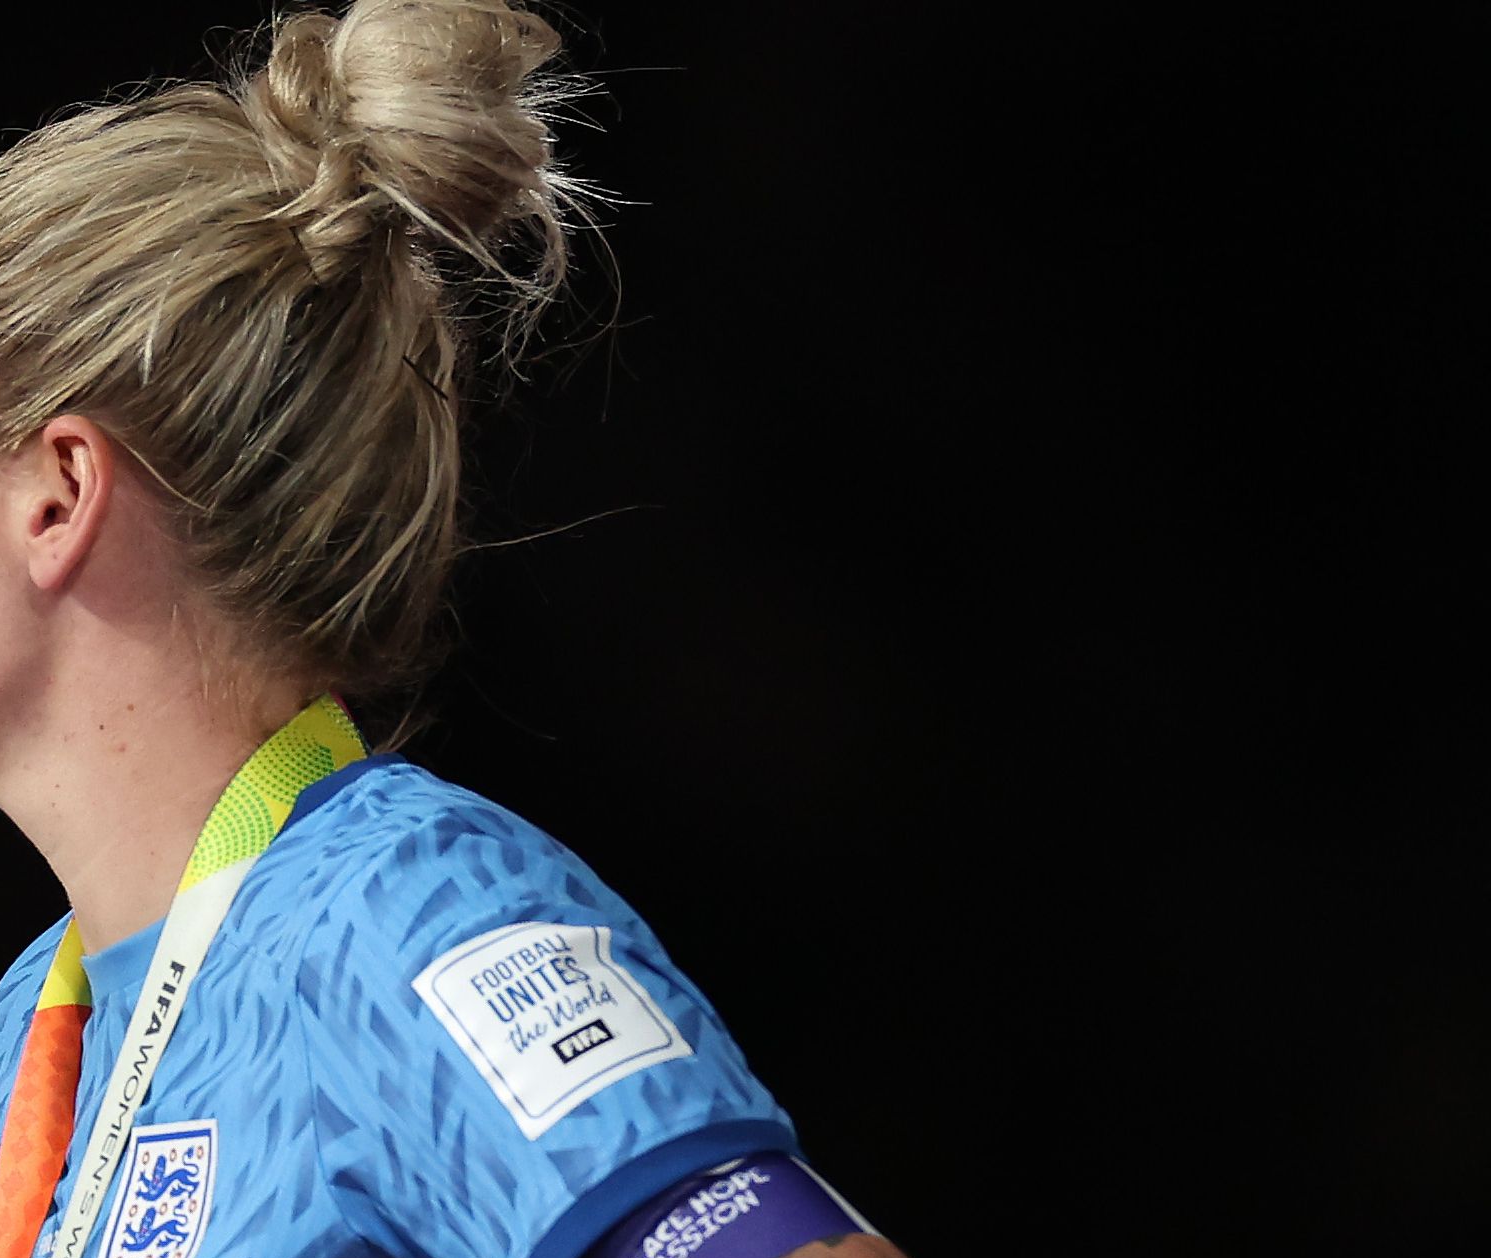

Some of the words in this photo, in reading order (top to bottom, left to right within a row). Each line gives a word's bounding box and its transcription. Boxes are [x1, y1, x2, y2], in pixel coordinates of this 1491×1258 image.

[145, 960, 186, 1037] FIFA
[471, 934, 572, 996] FOOTBALL
[486, 957, 591, 1022] UNITES
[507, 1022, 548, 1054] the
[544, 981, 619, 1028] World
[556, 1025, 608, 1059] FIFA
[79, 1045, 154, 1215] WOMEN'S
